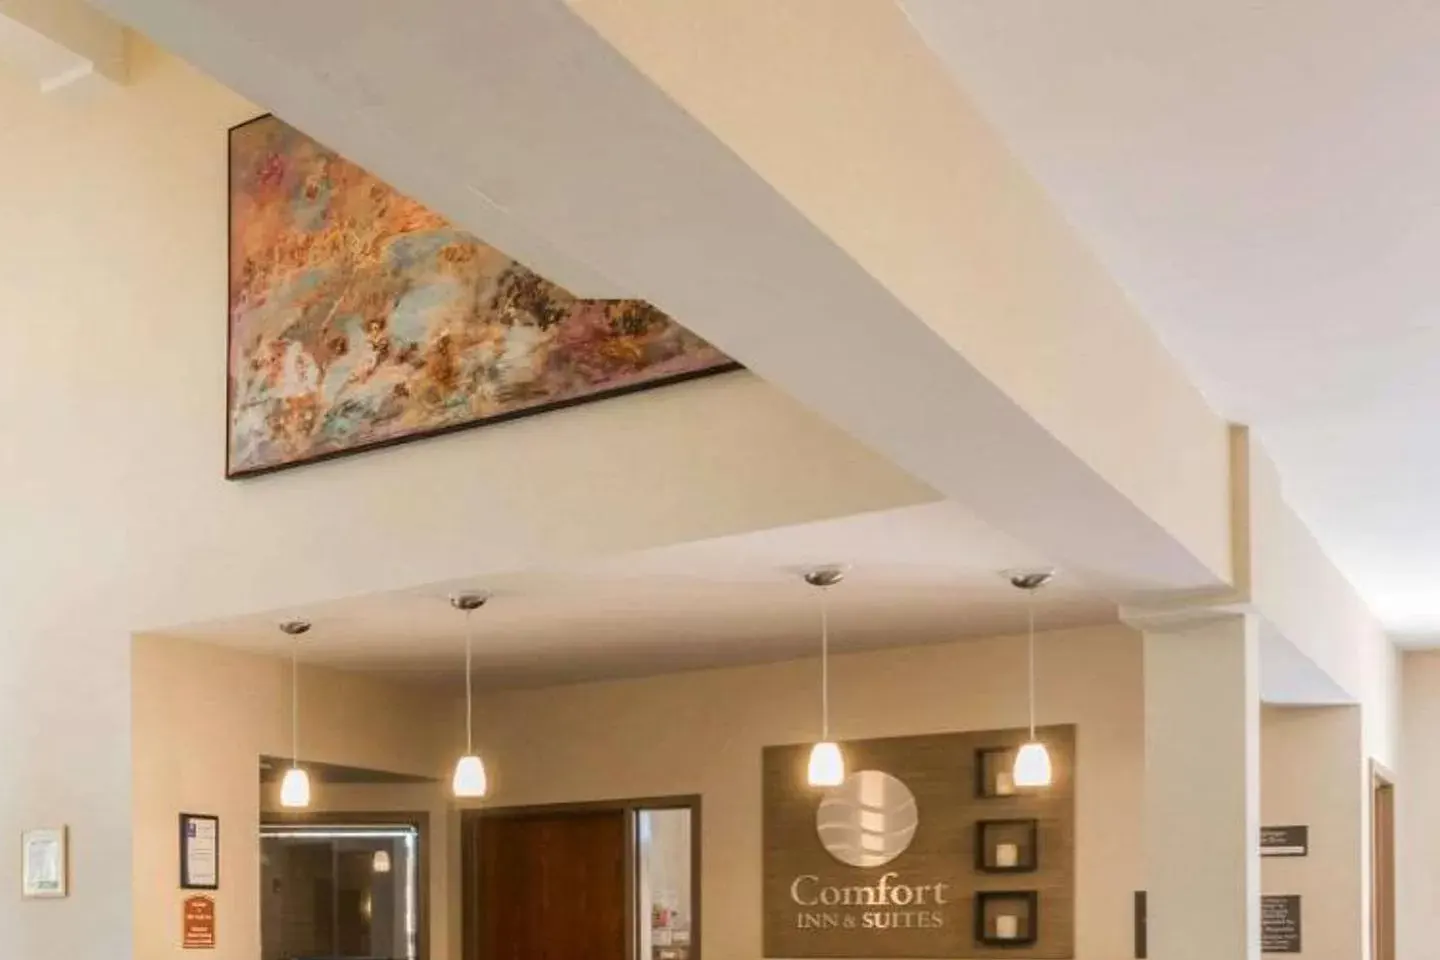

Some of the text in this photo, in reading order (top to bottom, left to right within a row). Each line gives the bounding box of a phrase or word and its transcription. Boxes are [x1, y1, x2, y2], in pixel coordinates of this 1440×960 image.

[790, 872, 950, 906] Comfort
[796, 910, 944, 929] INN & SUITES
